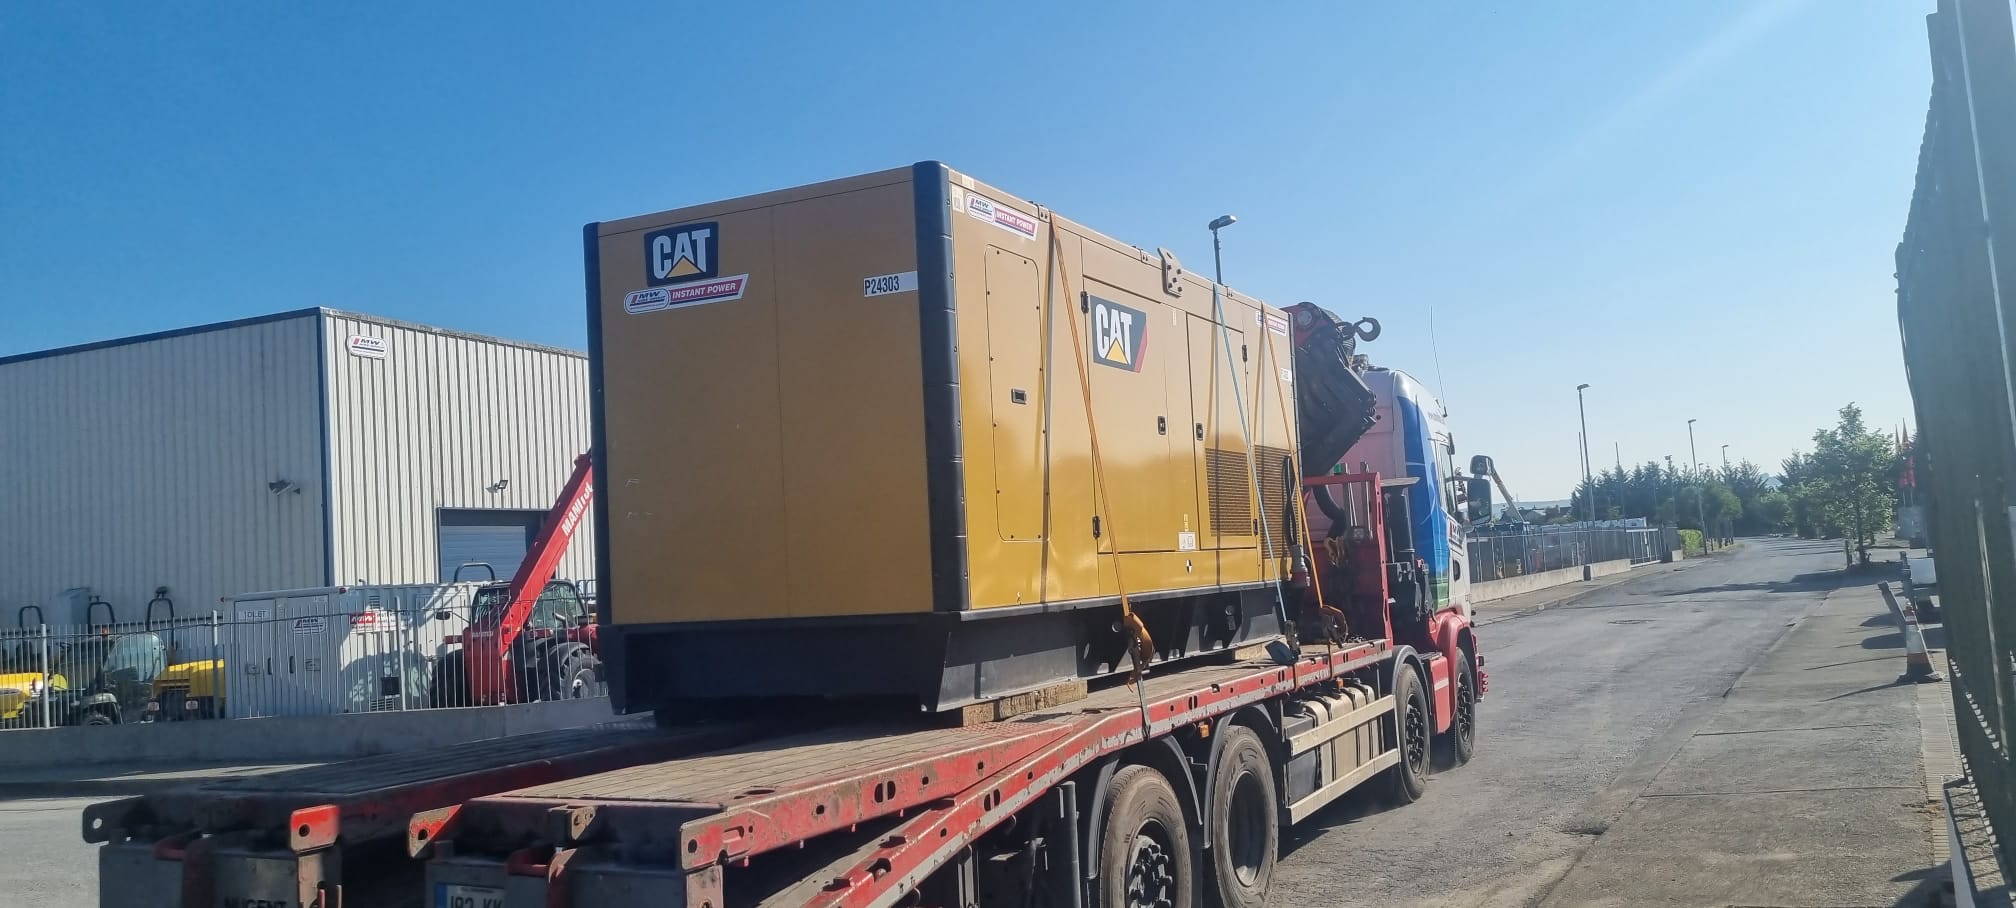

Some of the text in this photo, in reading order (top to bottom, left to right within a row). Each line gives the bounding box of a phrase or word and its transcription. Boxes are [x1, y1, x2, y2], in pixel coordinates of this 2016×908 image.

[996, 211, 1016, 225] INSTANT
[1017, 219, 1033, 233] POWER
[653, 228, 710, 279] CAT
[672, 287, 705, 299] INSTANT
[707, 282, 736, 294] POWER
[864, 275, 900, 295] P24303
[1095, 303, 1132, 365] CAT
